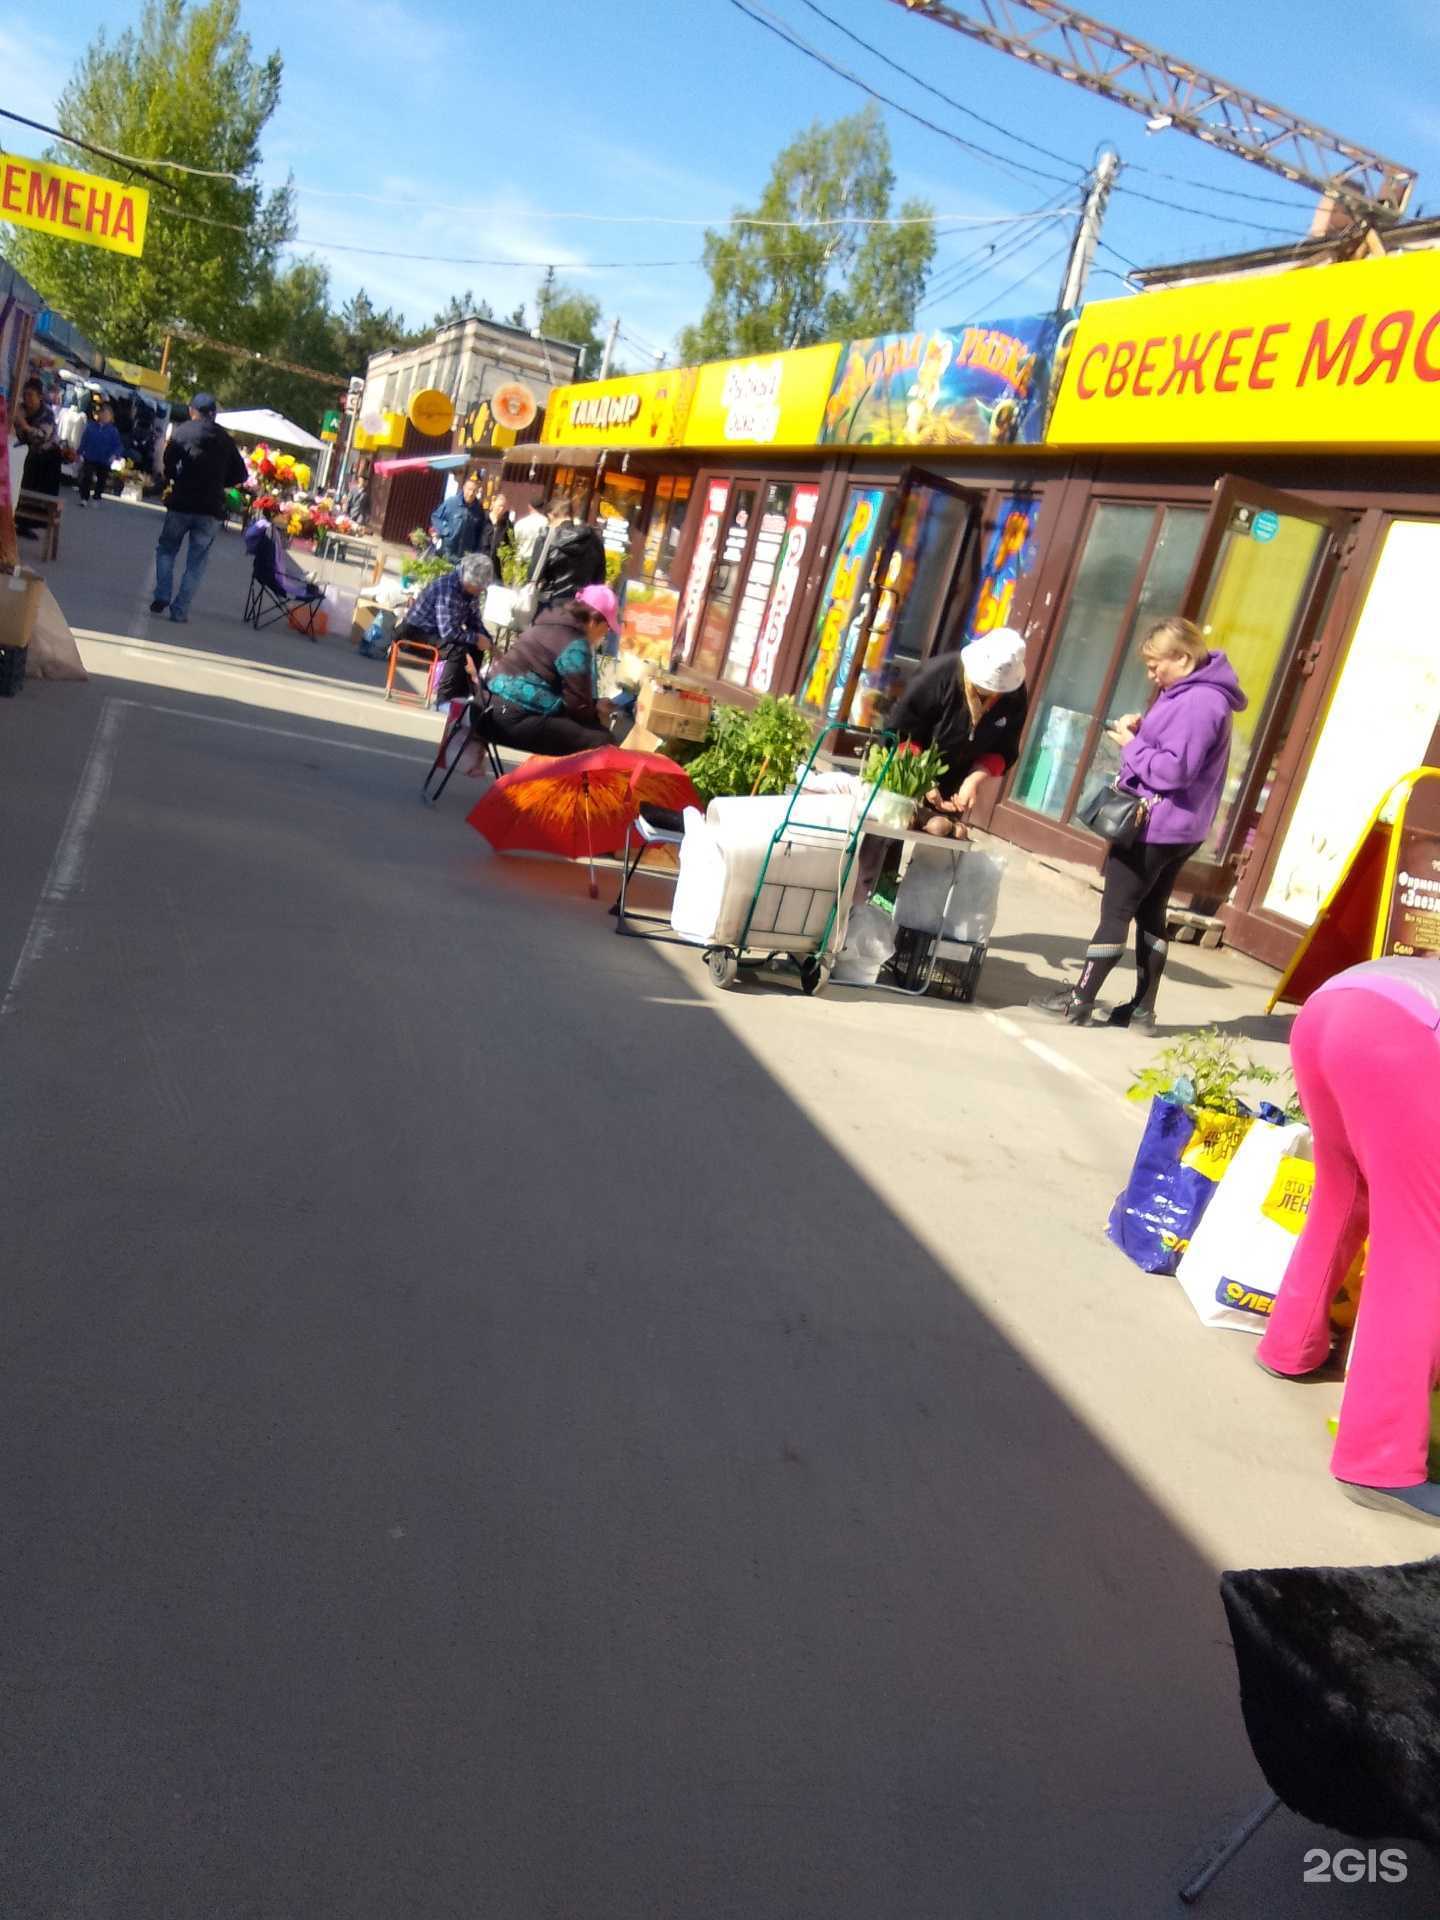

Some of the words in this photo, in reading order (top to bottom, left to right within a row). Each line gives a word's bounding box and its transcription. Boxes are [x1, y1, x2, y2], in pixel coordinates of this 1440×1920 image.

[0, 163, 135, 243] ЕМЕНА
[1076, 322, 1291, 400] СВЕЖЕЕ
[1296, 309, 1440, 389] МЯС
[571, 394, 642, 433] ТАНДЫР
[1400, 889, 1440, 913] «Звезд
[1278, 1192, 1312, 1215] ЛЕН
